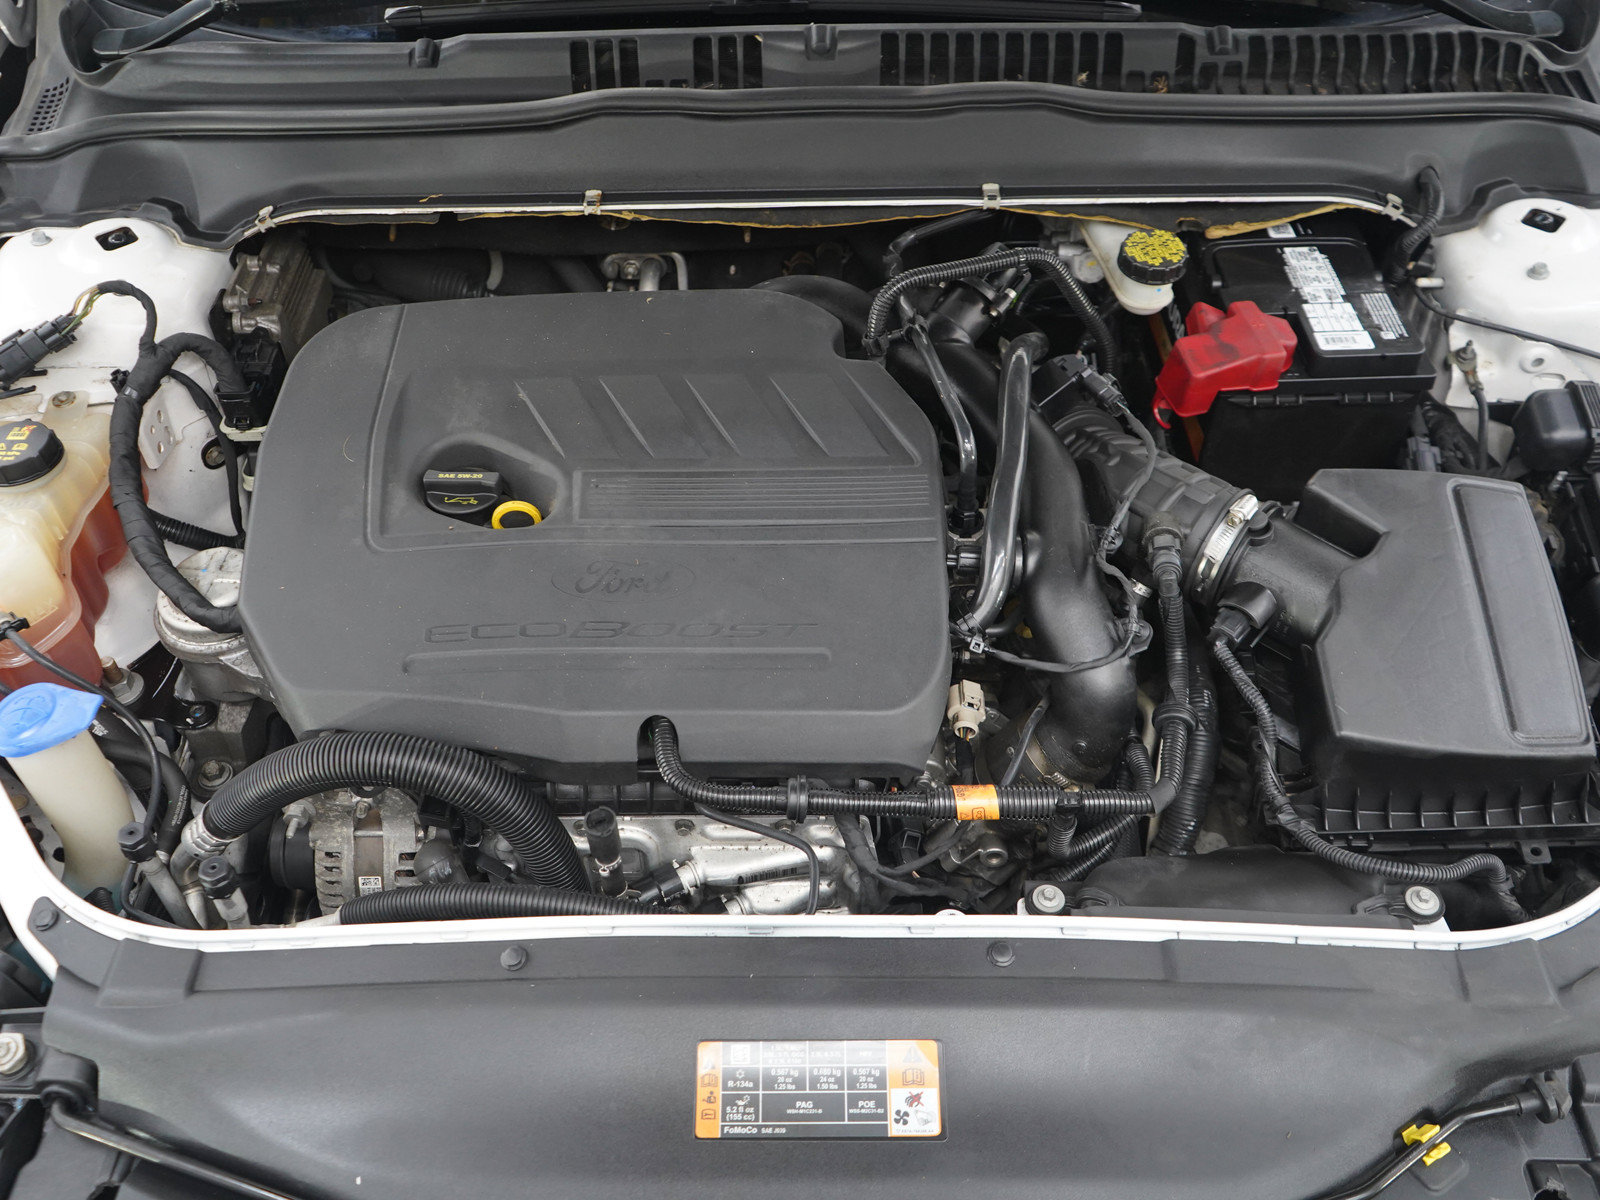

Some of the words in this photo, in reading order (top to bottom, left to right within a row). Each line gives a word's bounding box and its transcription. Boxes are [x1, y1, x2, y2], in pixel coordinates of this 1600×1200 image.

[574, 558, 673, 594] Ford
[790, 1068, 799, 1077] kg
[832, 1068, 842, 1077] kg
[871, 1068, 880, 1077] kg
[727, 1080, 754, 1088] R-134a
[795, 1101, 814, 1109] PAG
[858, 1100, 876, 1108] POE
[725, 1105, 738, 1113] 5.2
[725, 1113, 743, 1121] (155
[743, 1113, 756, 1121] cc)
[723, 1126, 758, 1134] FoMoCo
